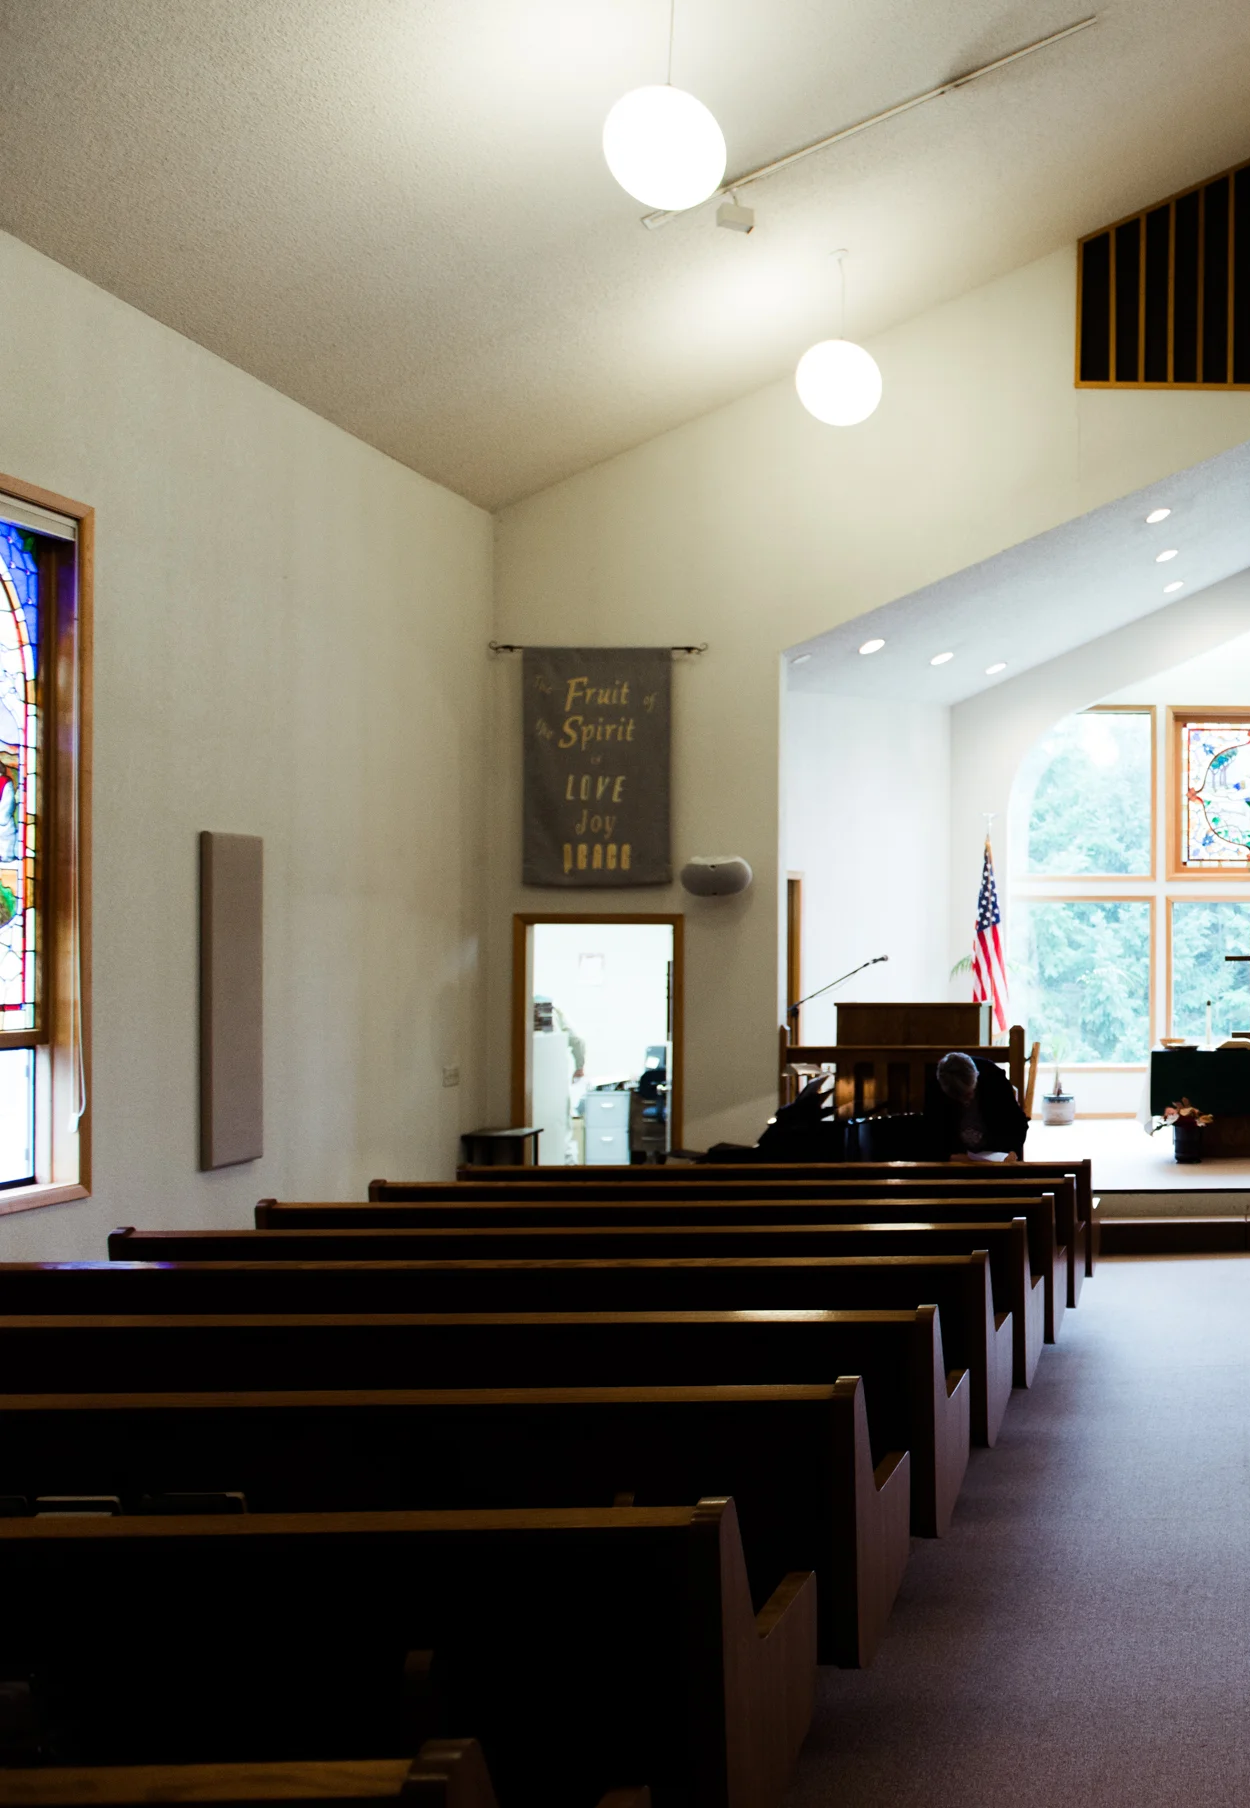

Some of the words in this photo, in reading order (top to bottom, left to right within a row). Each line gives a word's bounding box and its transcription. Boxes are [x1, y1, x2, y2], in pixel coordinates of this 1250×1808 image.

[564, 676, 630, 712] Fruit
[558, 715, 635, 750] Spirit
[565, 774, 626, 803] LOVE
[575, 809, 616, 839] Joy
